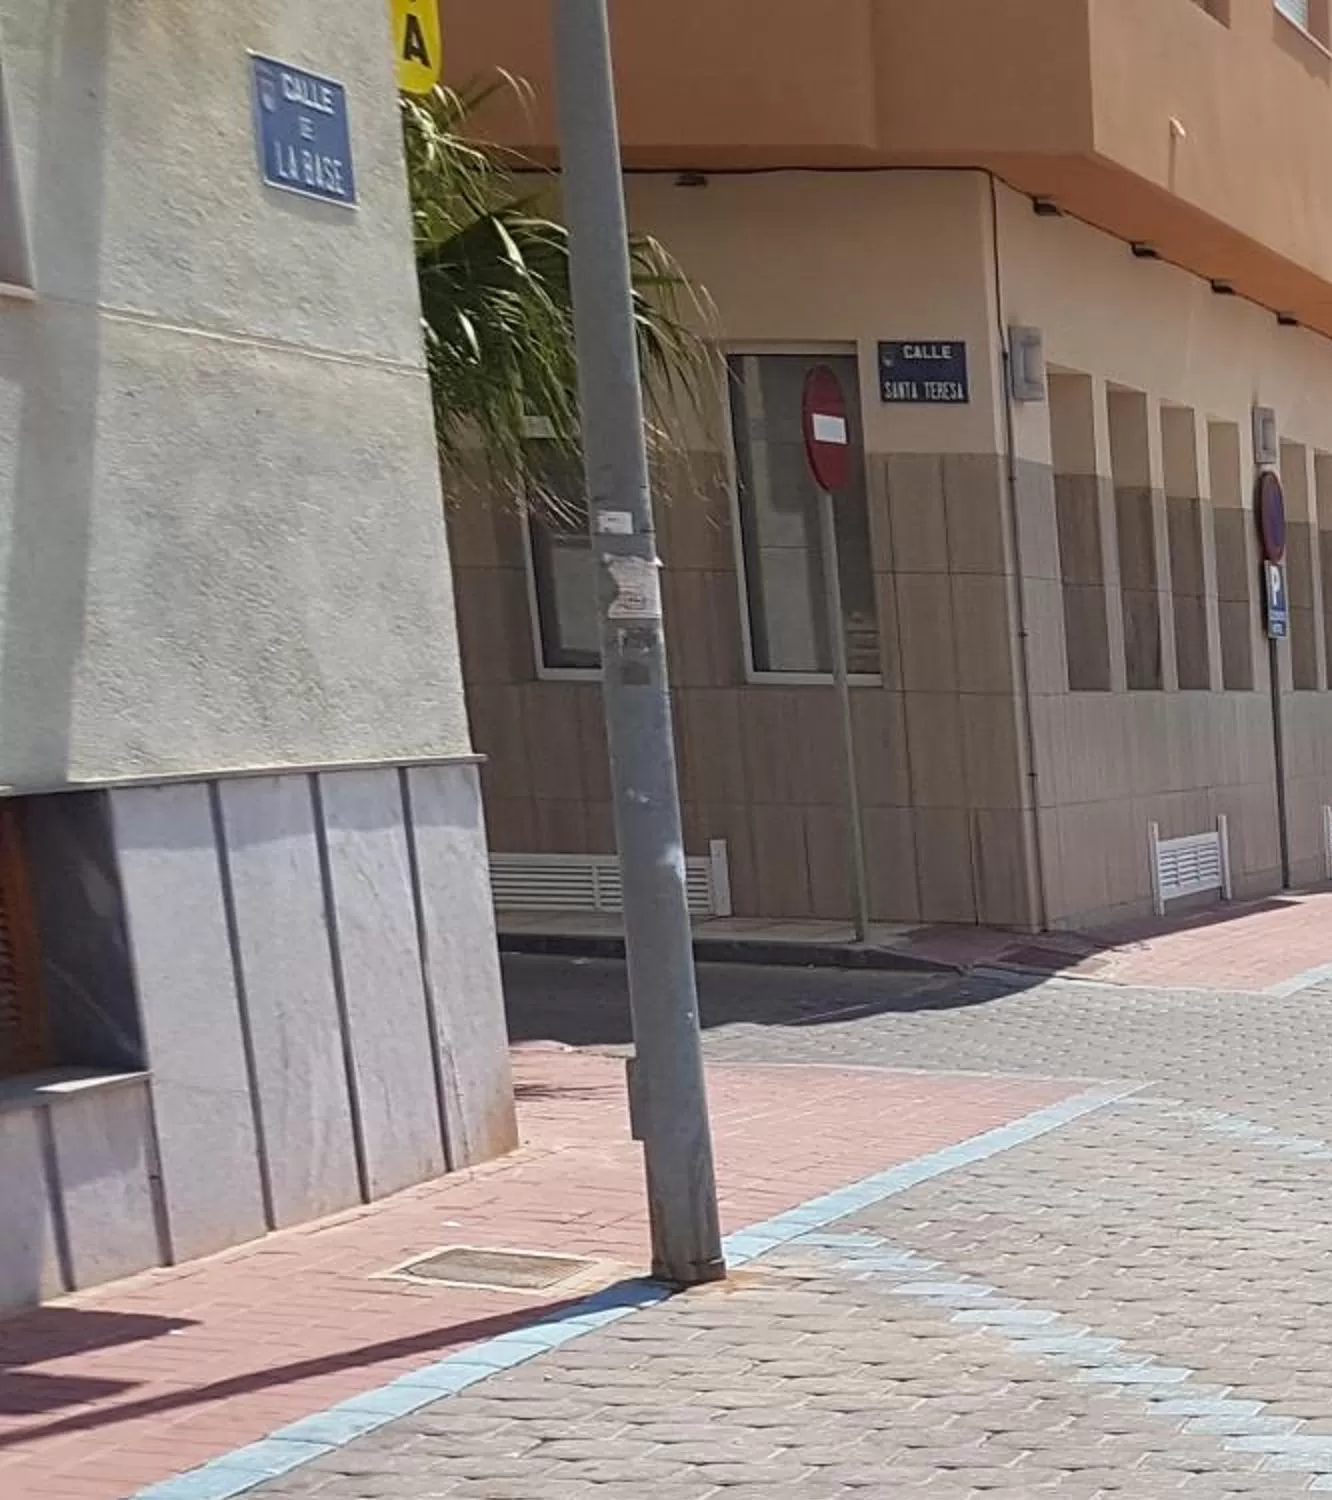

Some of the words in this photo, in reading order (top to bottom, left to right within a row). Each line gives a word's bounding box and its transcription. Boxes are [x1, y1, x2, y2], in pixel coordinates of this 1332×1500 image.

[281, 71, 336, 114] CALLE
[274, 140, 300, 180] LA
[301, 148, 346, 195] BASE
[903, 344, 953, 359] CALLE
[884, 381, 918, 400] SANTA
[923, 381, 965, 400] TERESA
[1270, 565, 1281, 607] P
